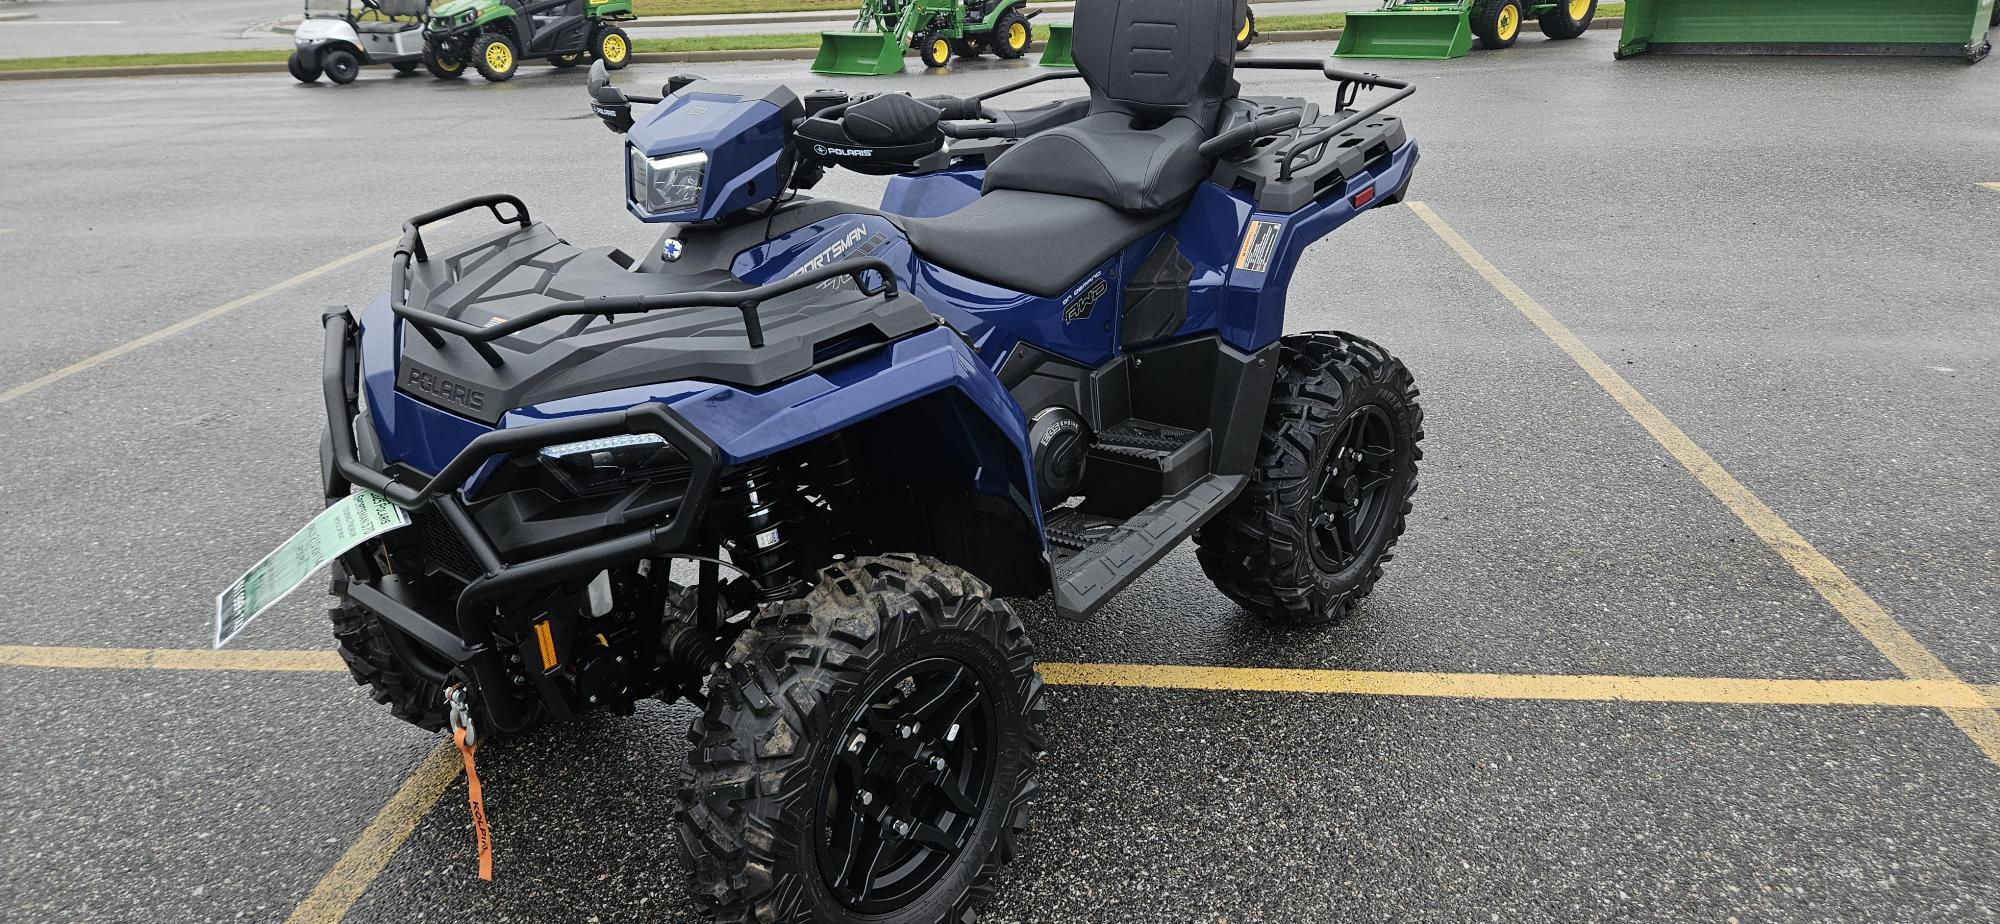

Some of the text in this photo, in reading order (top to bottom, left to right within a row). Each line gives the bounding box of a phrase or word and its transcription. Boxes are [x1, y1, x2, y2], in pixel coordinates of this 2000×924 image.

[828, 147, 872, 157] POLARIS
[785, 223, 867, 278] ORTSMAN
[1065, 282, 1105, 325] AWD
[408, 367, 484, 413] POLARIS
[472, 800, 489, 850] KOLPIN
